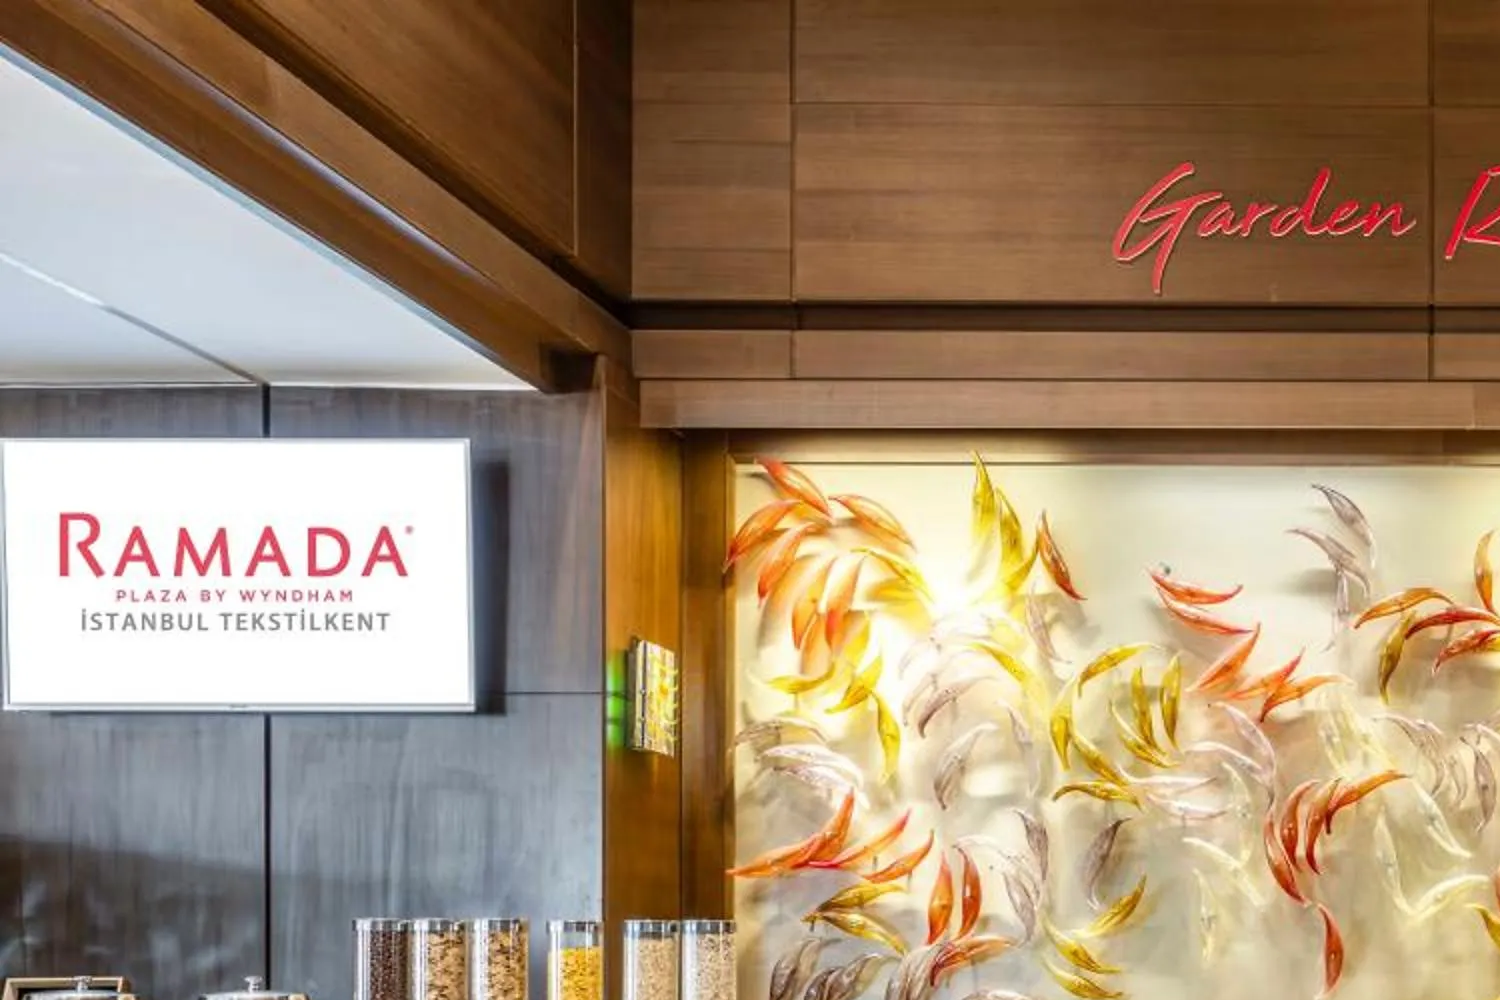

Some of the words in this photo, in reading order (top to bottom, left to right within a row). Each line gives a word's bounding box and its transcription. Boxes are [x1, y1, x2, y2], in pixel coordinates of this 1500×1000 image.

[1113, 162, 1417, 294] Garden
[58, 512, 408, 578] RAMADA
[116, 590, 188, 603] PLAZA
[200, 590, 227, 603] BY
[239, 590, 353, 603] WYNDHAM
[81, 608, 209, 632] İSTANBUL
[219, 608, 391, 632] TEKSTİLKENT
